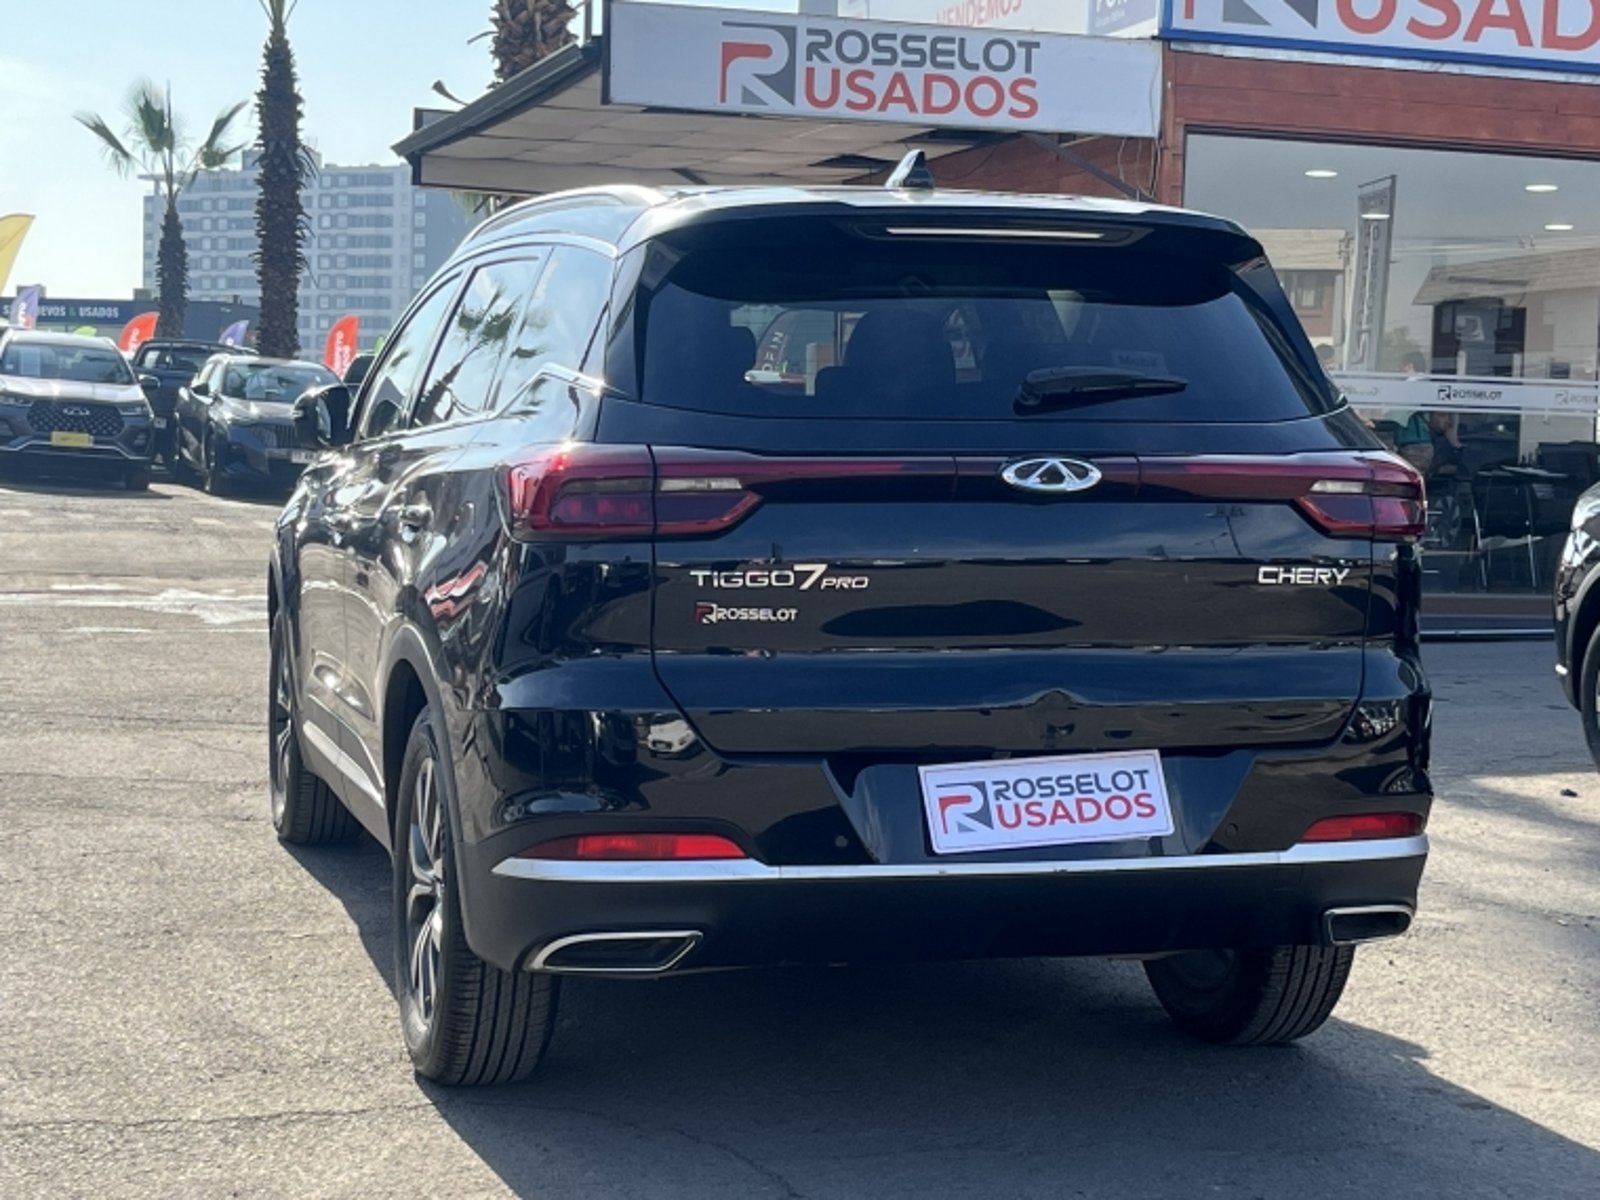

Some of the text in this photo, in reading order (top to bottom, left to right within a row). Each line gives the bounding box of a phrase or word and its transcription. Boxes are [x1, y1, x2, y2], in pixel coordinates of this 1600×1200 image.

[805, 28, 1041, 75] ROSSELOT
[805, 67, 1039, 119] USADOS
[79, 306, 119, 319] USADOS
[820, 575, 869, 590] PRO
[1257, 565, 1350, 585] CHERY
[717, 607, 799, 623] ROSSELOT
[991, 769, 1149, 801] ROSSELOT
[996, 792, 1157, 830] USADOS
